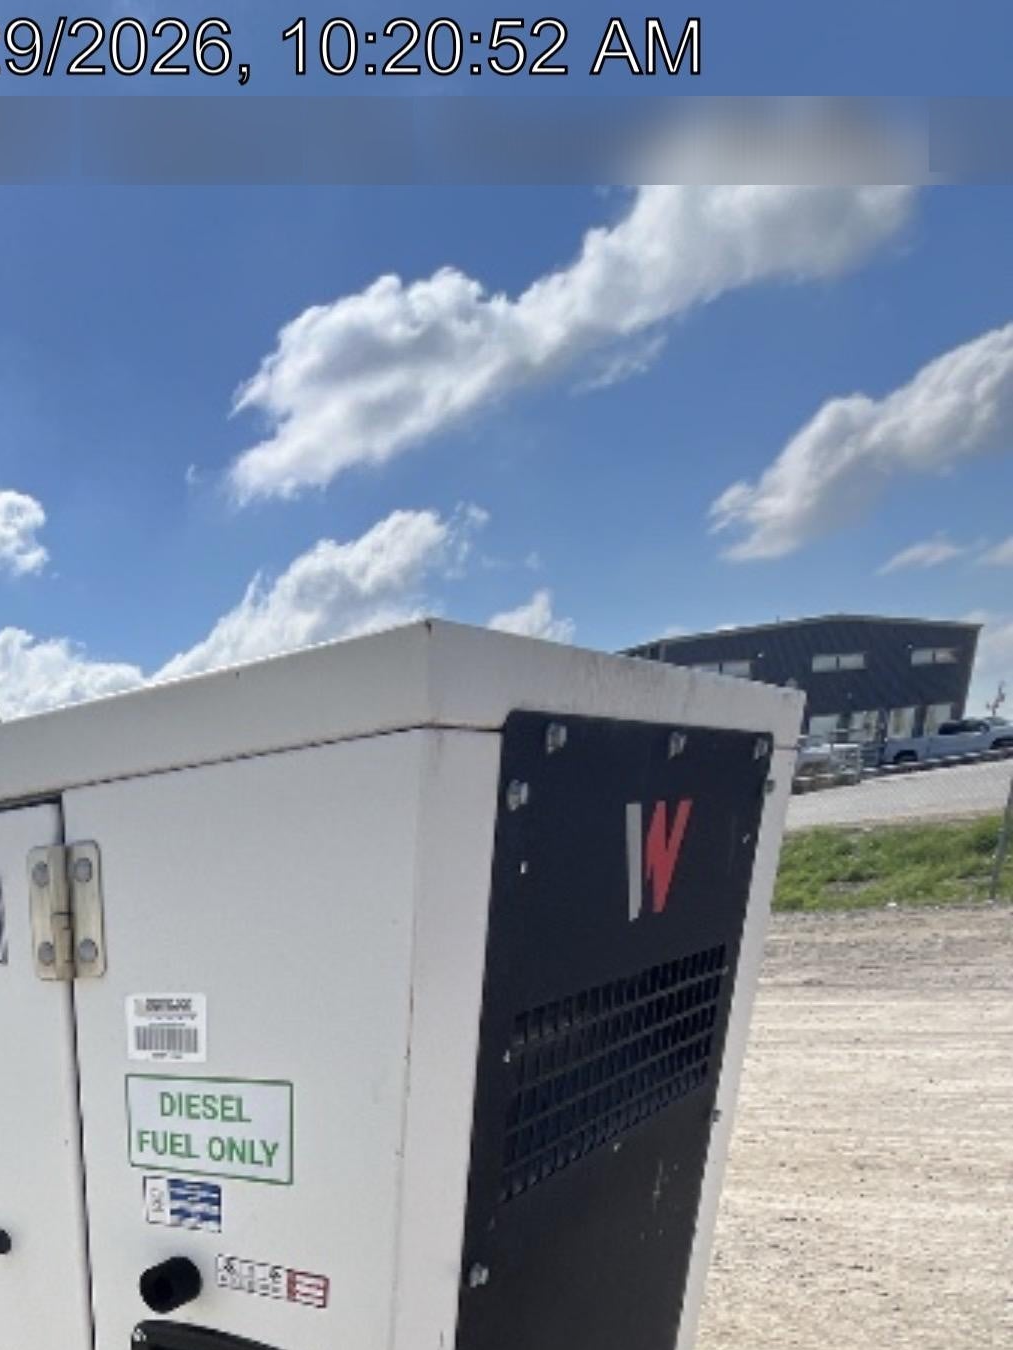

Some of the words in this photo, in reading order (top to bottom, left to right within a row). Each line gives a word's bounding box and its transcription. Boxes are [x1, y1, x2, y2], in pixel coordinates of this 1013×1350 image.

[159, 1091, 252, 1123] DIESEL
[138, 1129, 200, 1159] FUEL
[207, 1136, 280, 1168] ONLY
